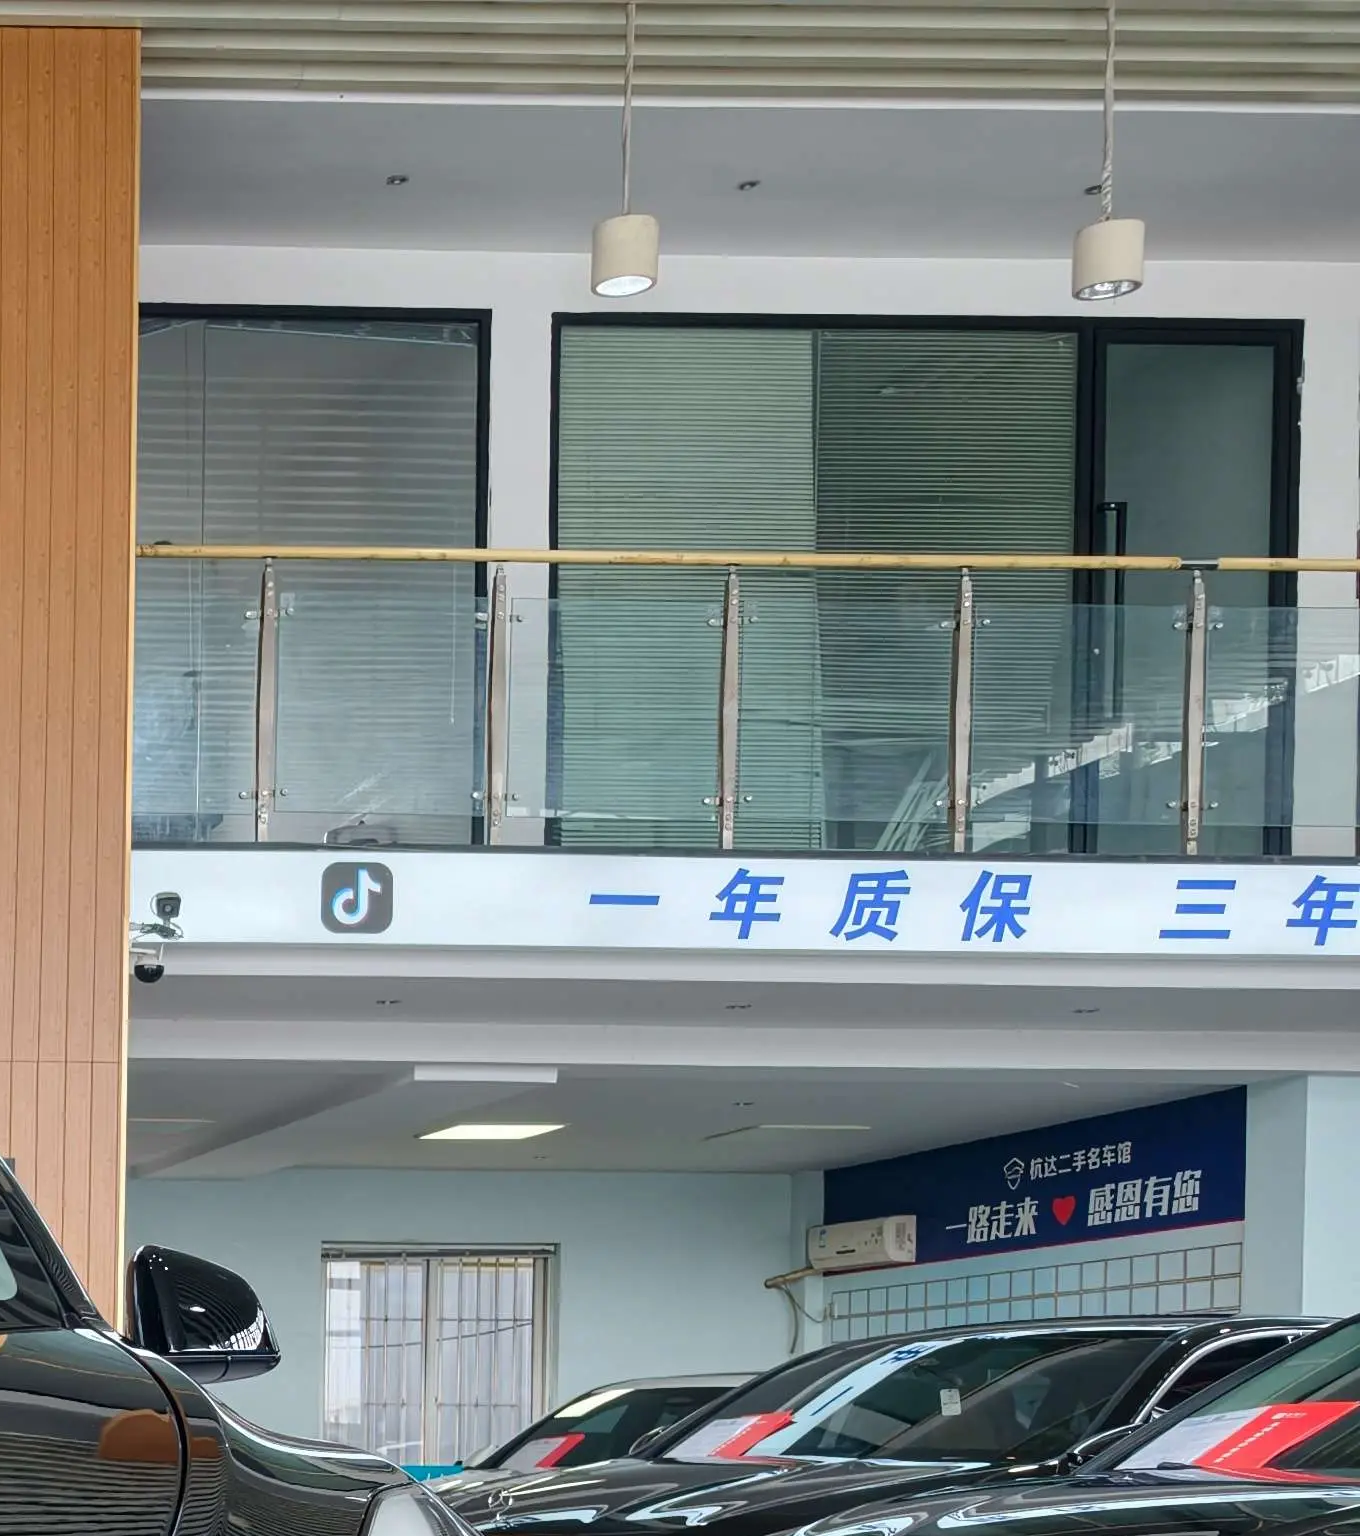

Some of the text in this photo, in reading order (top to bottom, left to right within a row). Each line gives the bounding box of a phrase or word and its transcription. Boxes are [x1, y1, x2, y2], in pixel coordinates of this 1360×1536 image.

[589, 867, 1360, 946] 一年质保 三年
[1029, 1141, 1132, 1181] 杭达二手名车馆
[945, 1169, 1202, 1244] 一路走来 感恩有您
